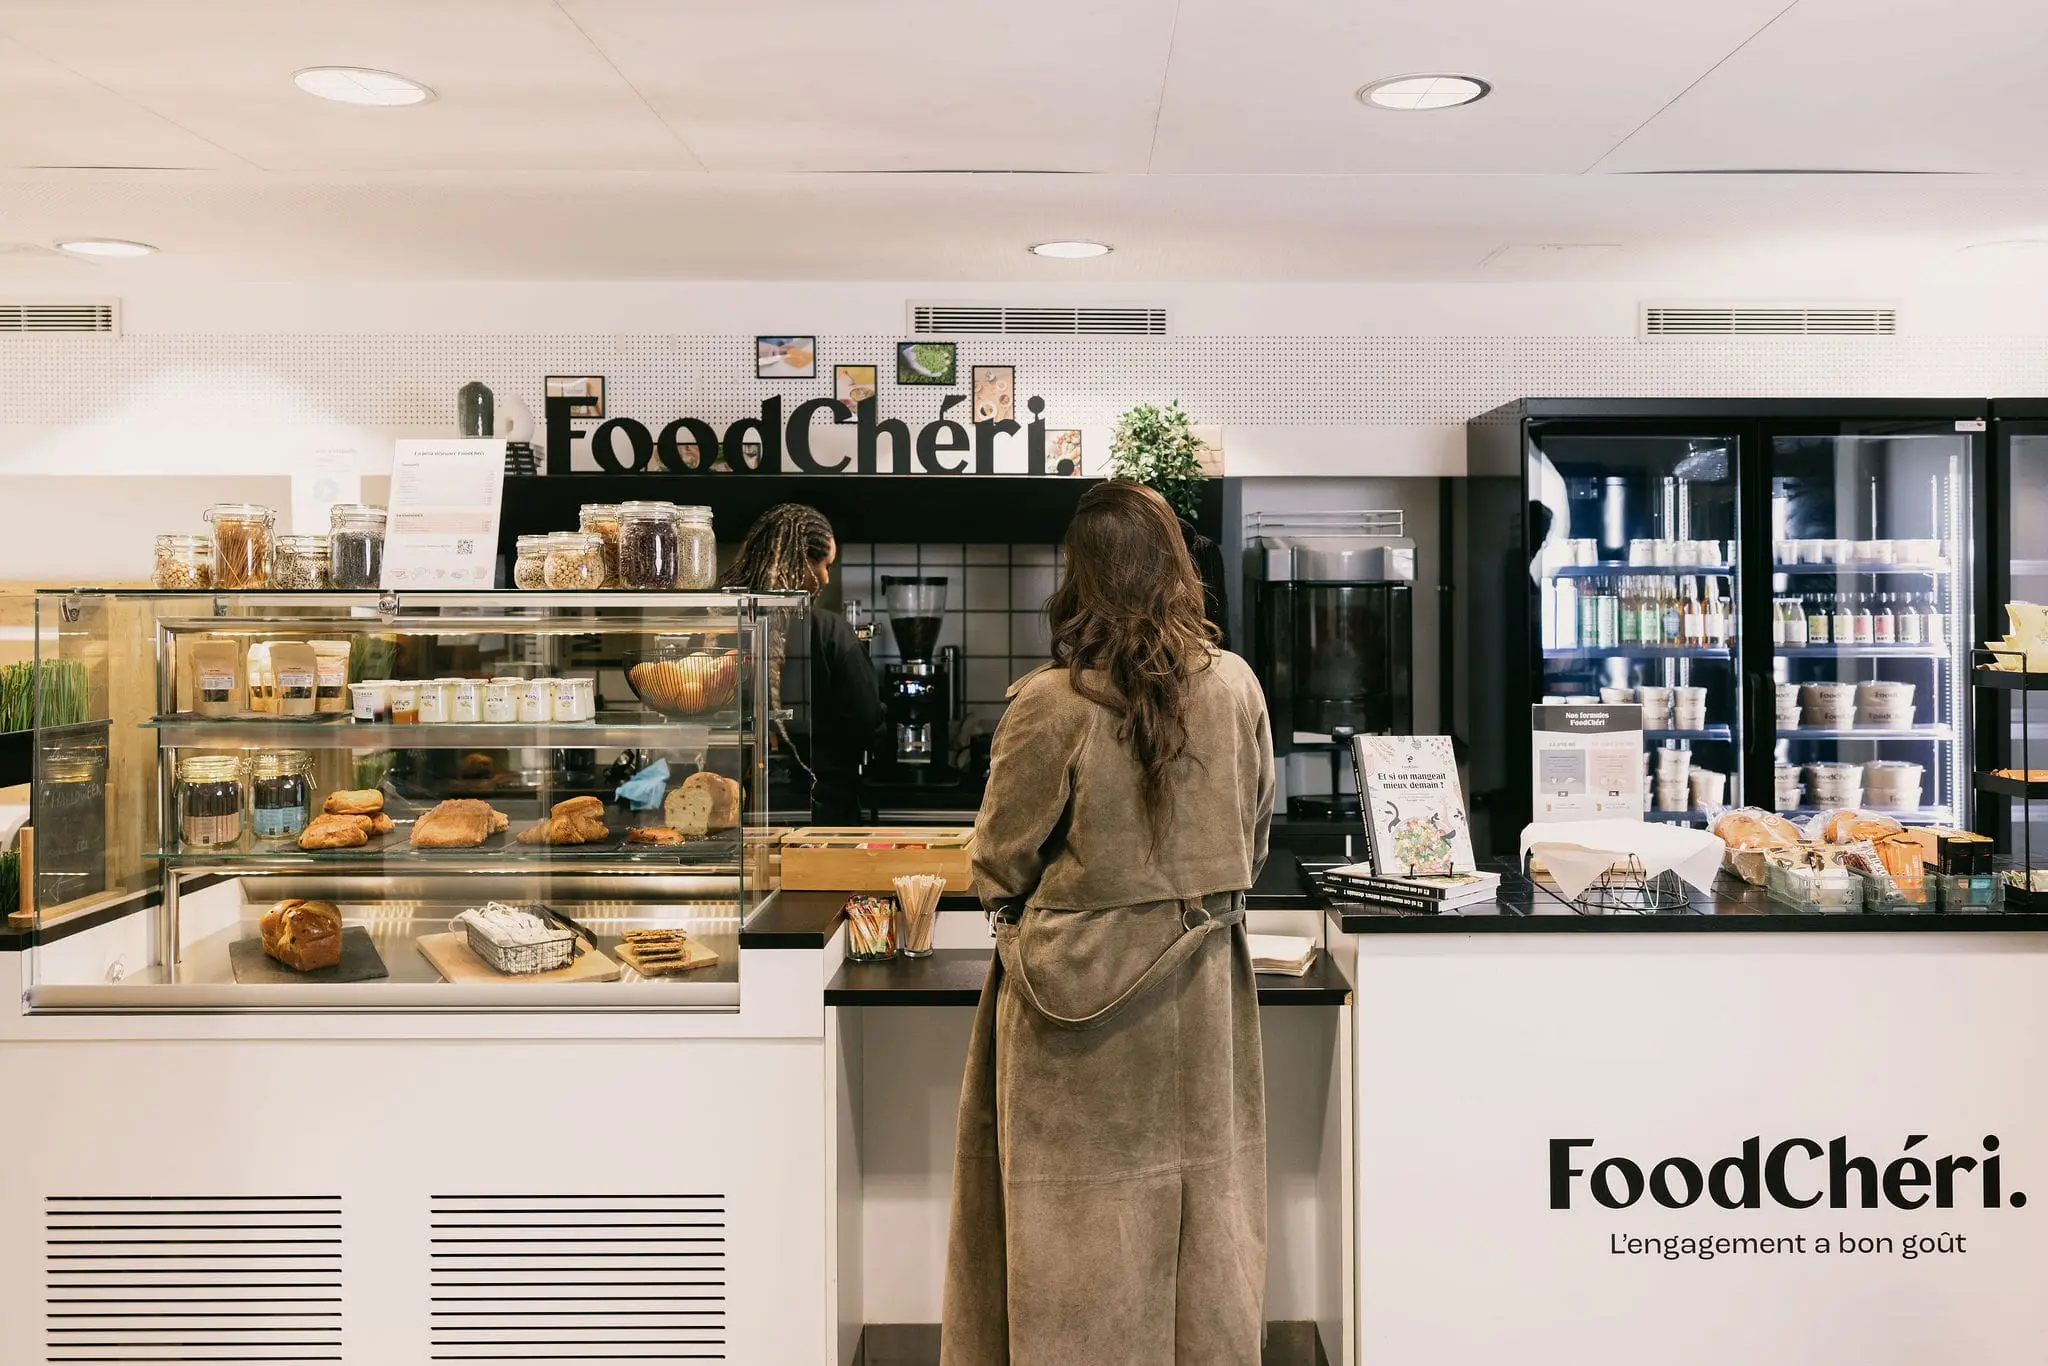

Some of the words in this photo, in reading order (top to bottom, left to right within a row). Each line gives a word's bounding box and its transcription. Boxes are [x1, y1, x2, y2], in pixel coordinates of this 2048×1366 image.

[545, 394, 1076, 475] FoodChéri.
[1383, 781, 1408, 789] mieux
[1410, 781, 1439, 789] demain
[1410, 773, 1446, 781] mangeait
[1550, 1135, 2026, 1210] FoodChéri.
[1815, 1238, 1829, 1253] a
[1840, 1232, 1892, 1253] bon
[1903, 1232, 1966, 1259] goût
